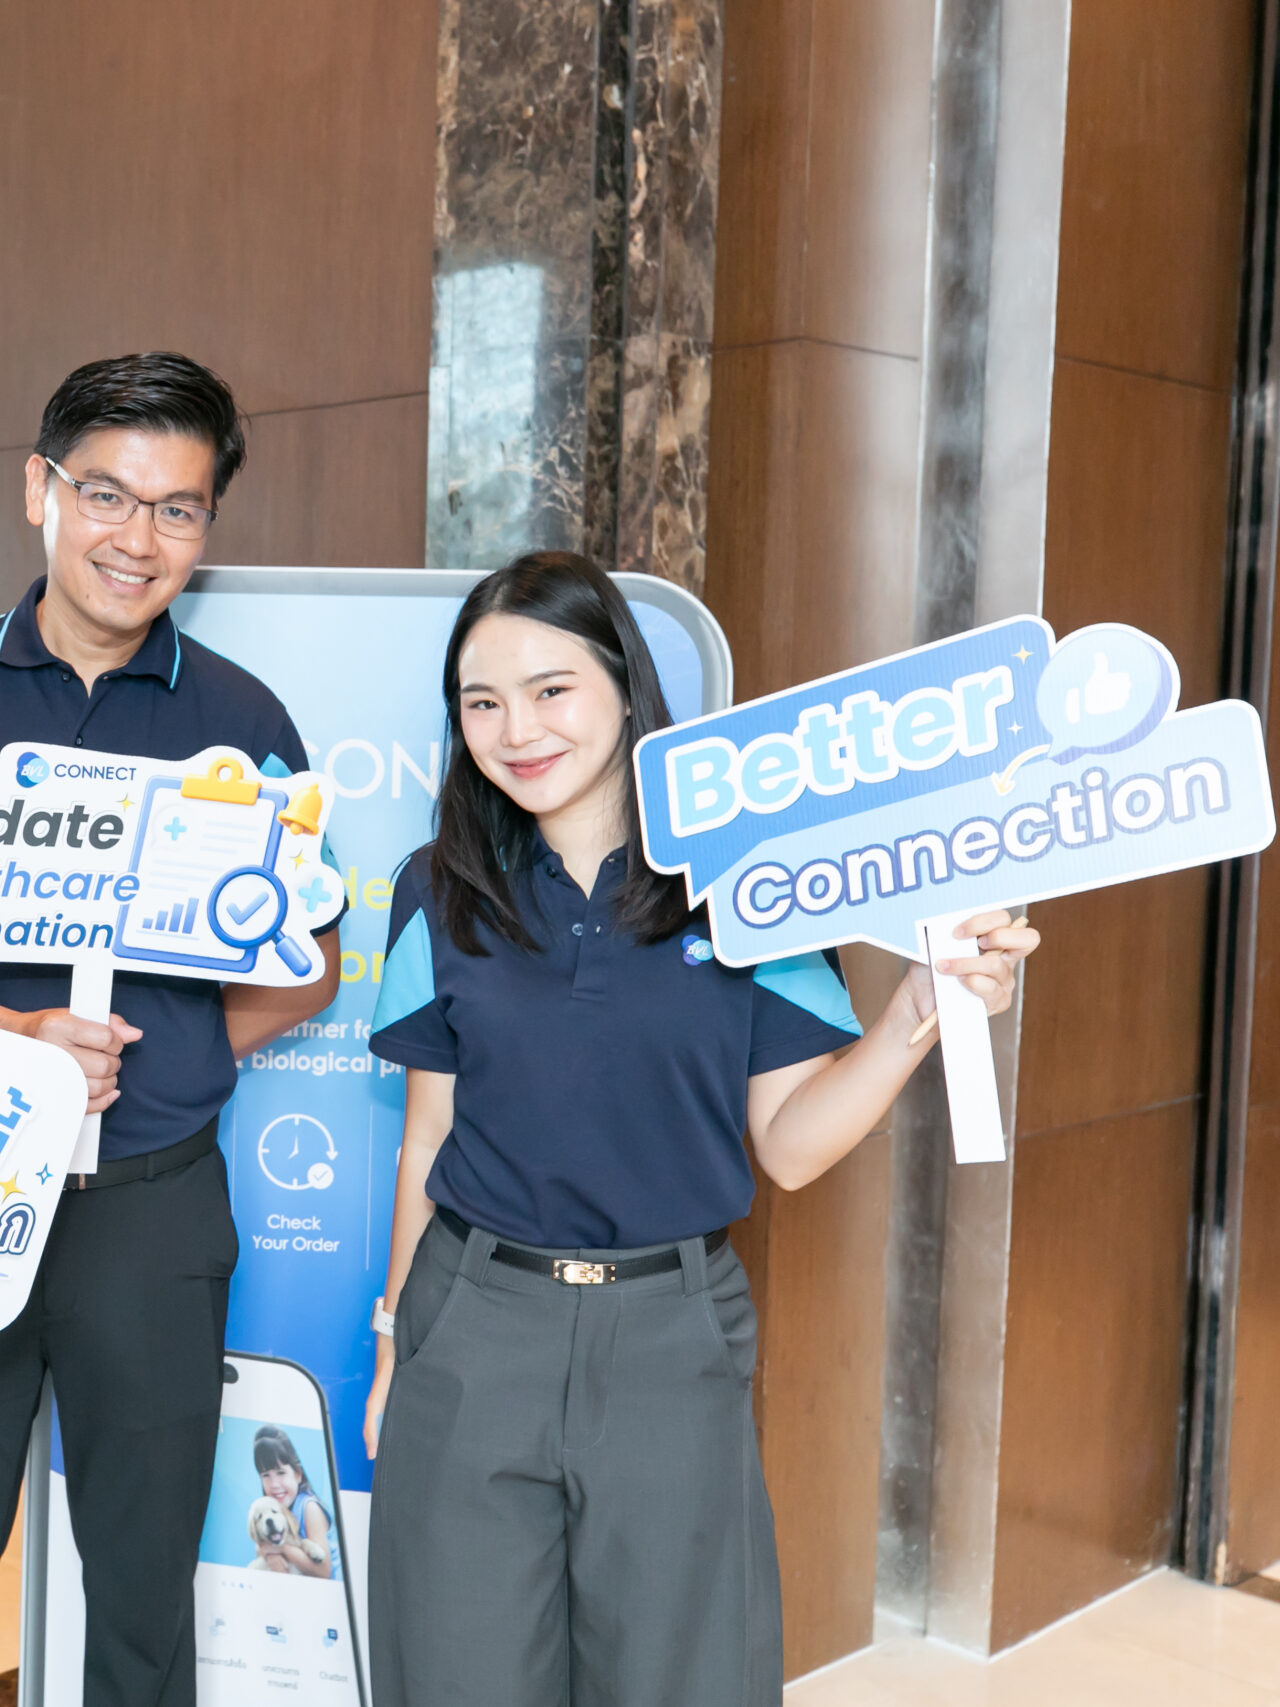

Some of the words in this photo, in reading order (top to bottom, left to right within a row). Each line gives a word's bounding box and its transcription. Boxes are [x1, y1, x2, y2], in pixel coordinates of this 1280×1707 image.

[672, 674, 1005, 831] Better
[19, 763, 48, 782] BVL
[53, 763, 137, 781] CONNECT
[304, 739, 440, 800] ON
[734, 757, 1229, 927] Connection
[251, 1048, 373, 1077] biological
[266, 1214, 322, 1231] Check
[252, 1235, 289, 1251] Your
[292, 1236, 341, 1253] Order
